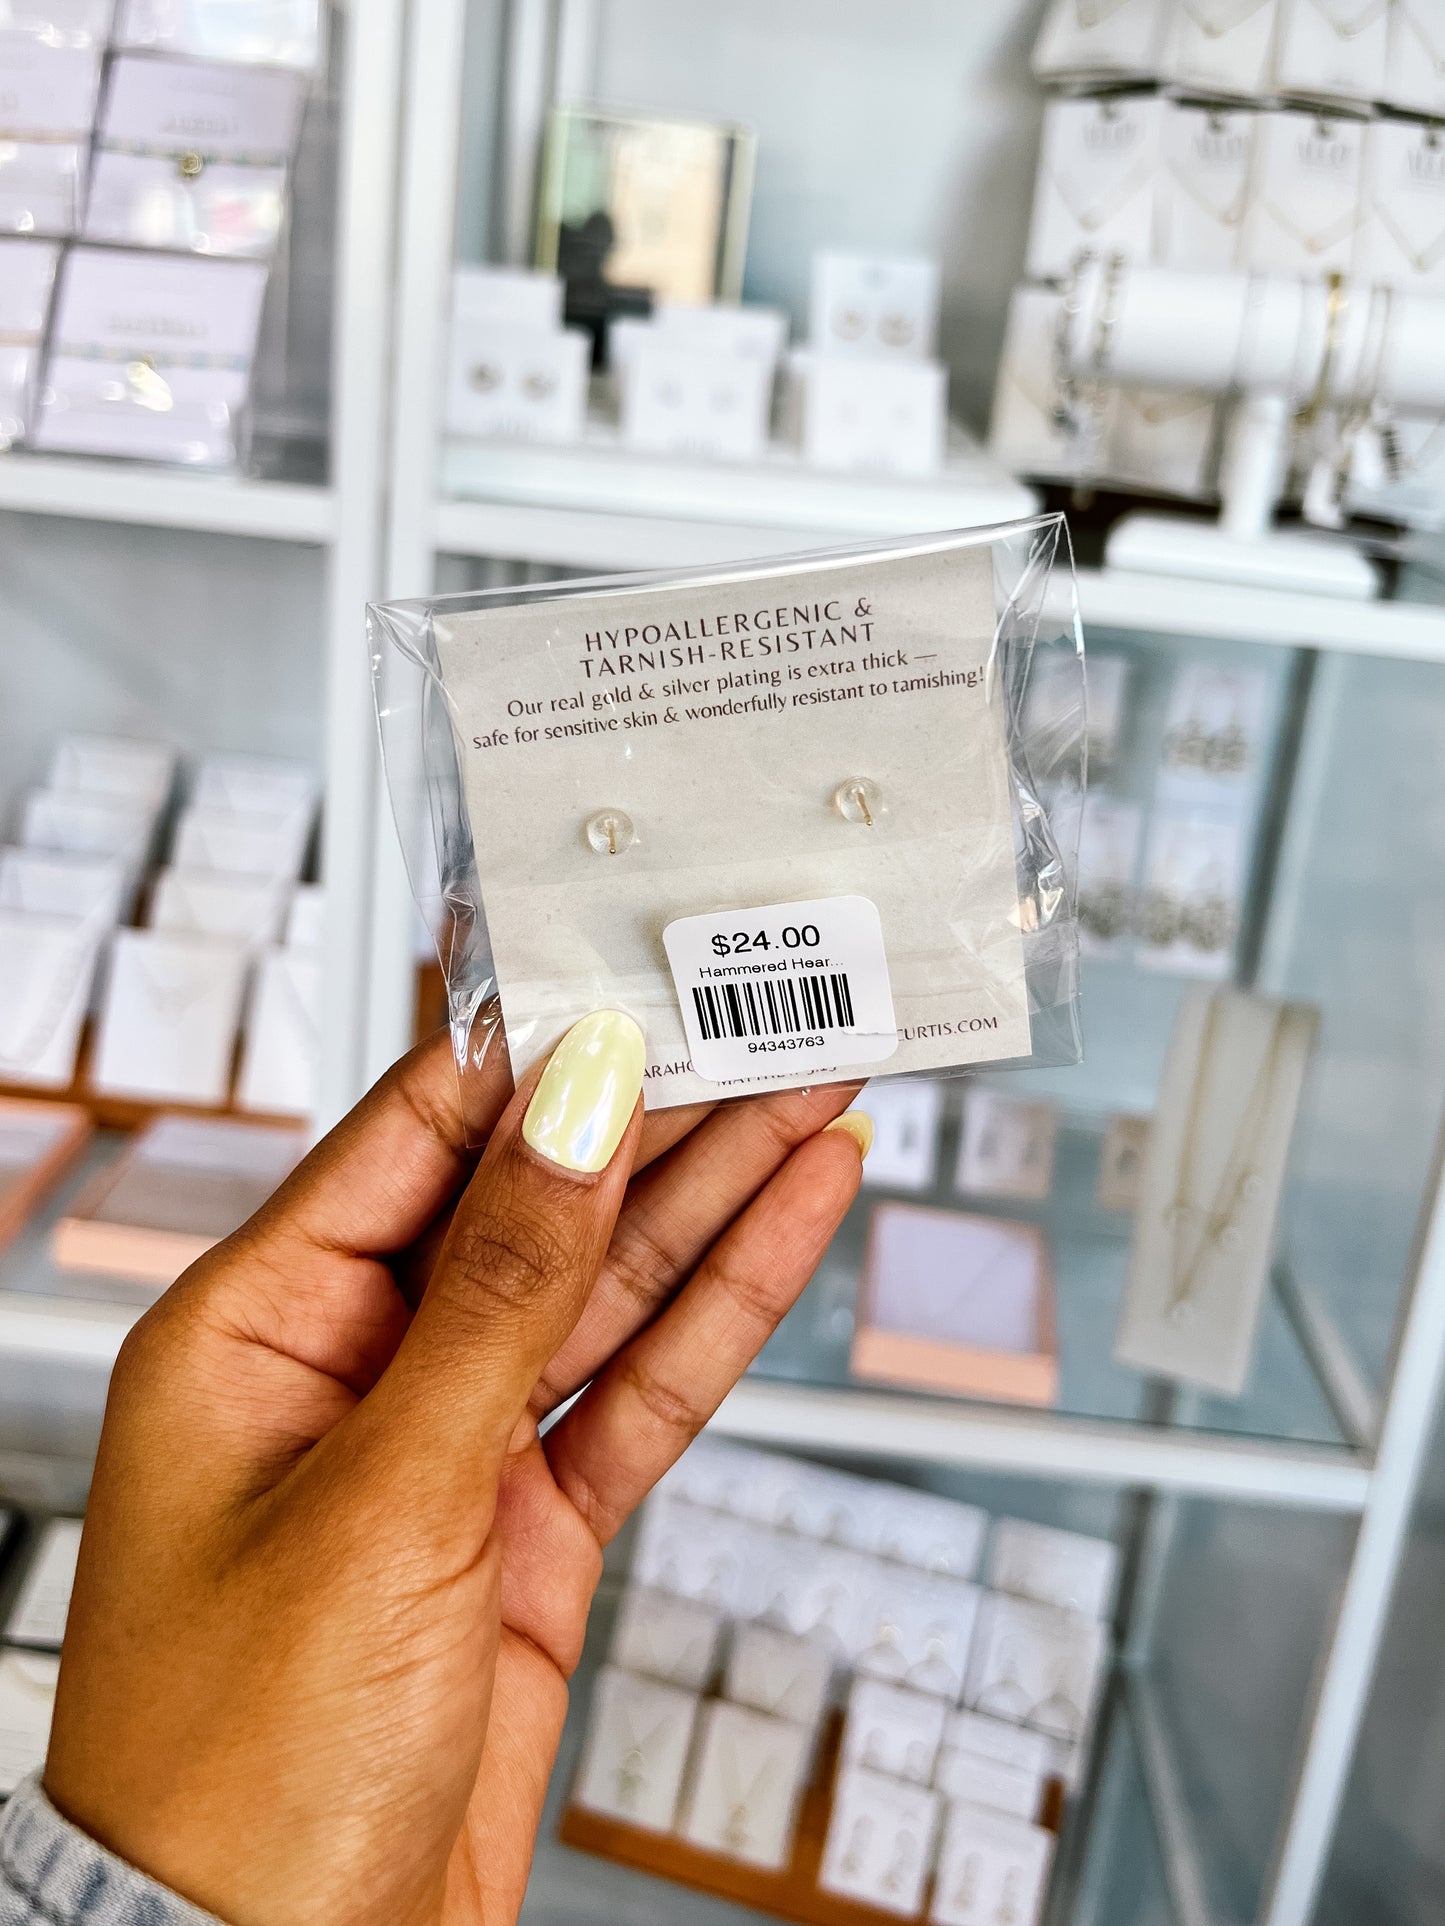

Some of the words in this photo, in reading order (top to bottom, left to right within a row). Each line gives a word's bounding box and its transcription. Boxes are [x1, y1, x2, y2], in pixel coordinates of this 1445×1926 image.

[580, 622, 875, 678] TARNISH-RESISTANT
[585, 601, 842, 652] HYPOALLERGENIC
[854, 597, 873, 618] &
[507, 699, 543, 717] Our
[550, 691, 585, 712] real
[592, 685, 632, 710] gold
[638, 683, 656, 700] &
[662, 678, 710, 697] silver
[717, 669, 782, 693] plating
[787, 664, 802, 680] is
[807, 660, 855, 678] extra
[862, 649, 909, 671] thick
[473, 731, 509, 749] safe
[514, 727, 540, 744] for
[545, 715, 618, 740] sensitive
[623, 711, 658, 729] skin
[663, 707, 680, 723] &
[685, 693, 787, 719] wonderfully
[792, 684, 865, 707] resistant
[870, 681, 888, 697] to
[711, 924, 821, 958] $24.00
[699, 959, 788, 979] Hammered
[747, 1035, 825, 1053] 94343763
